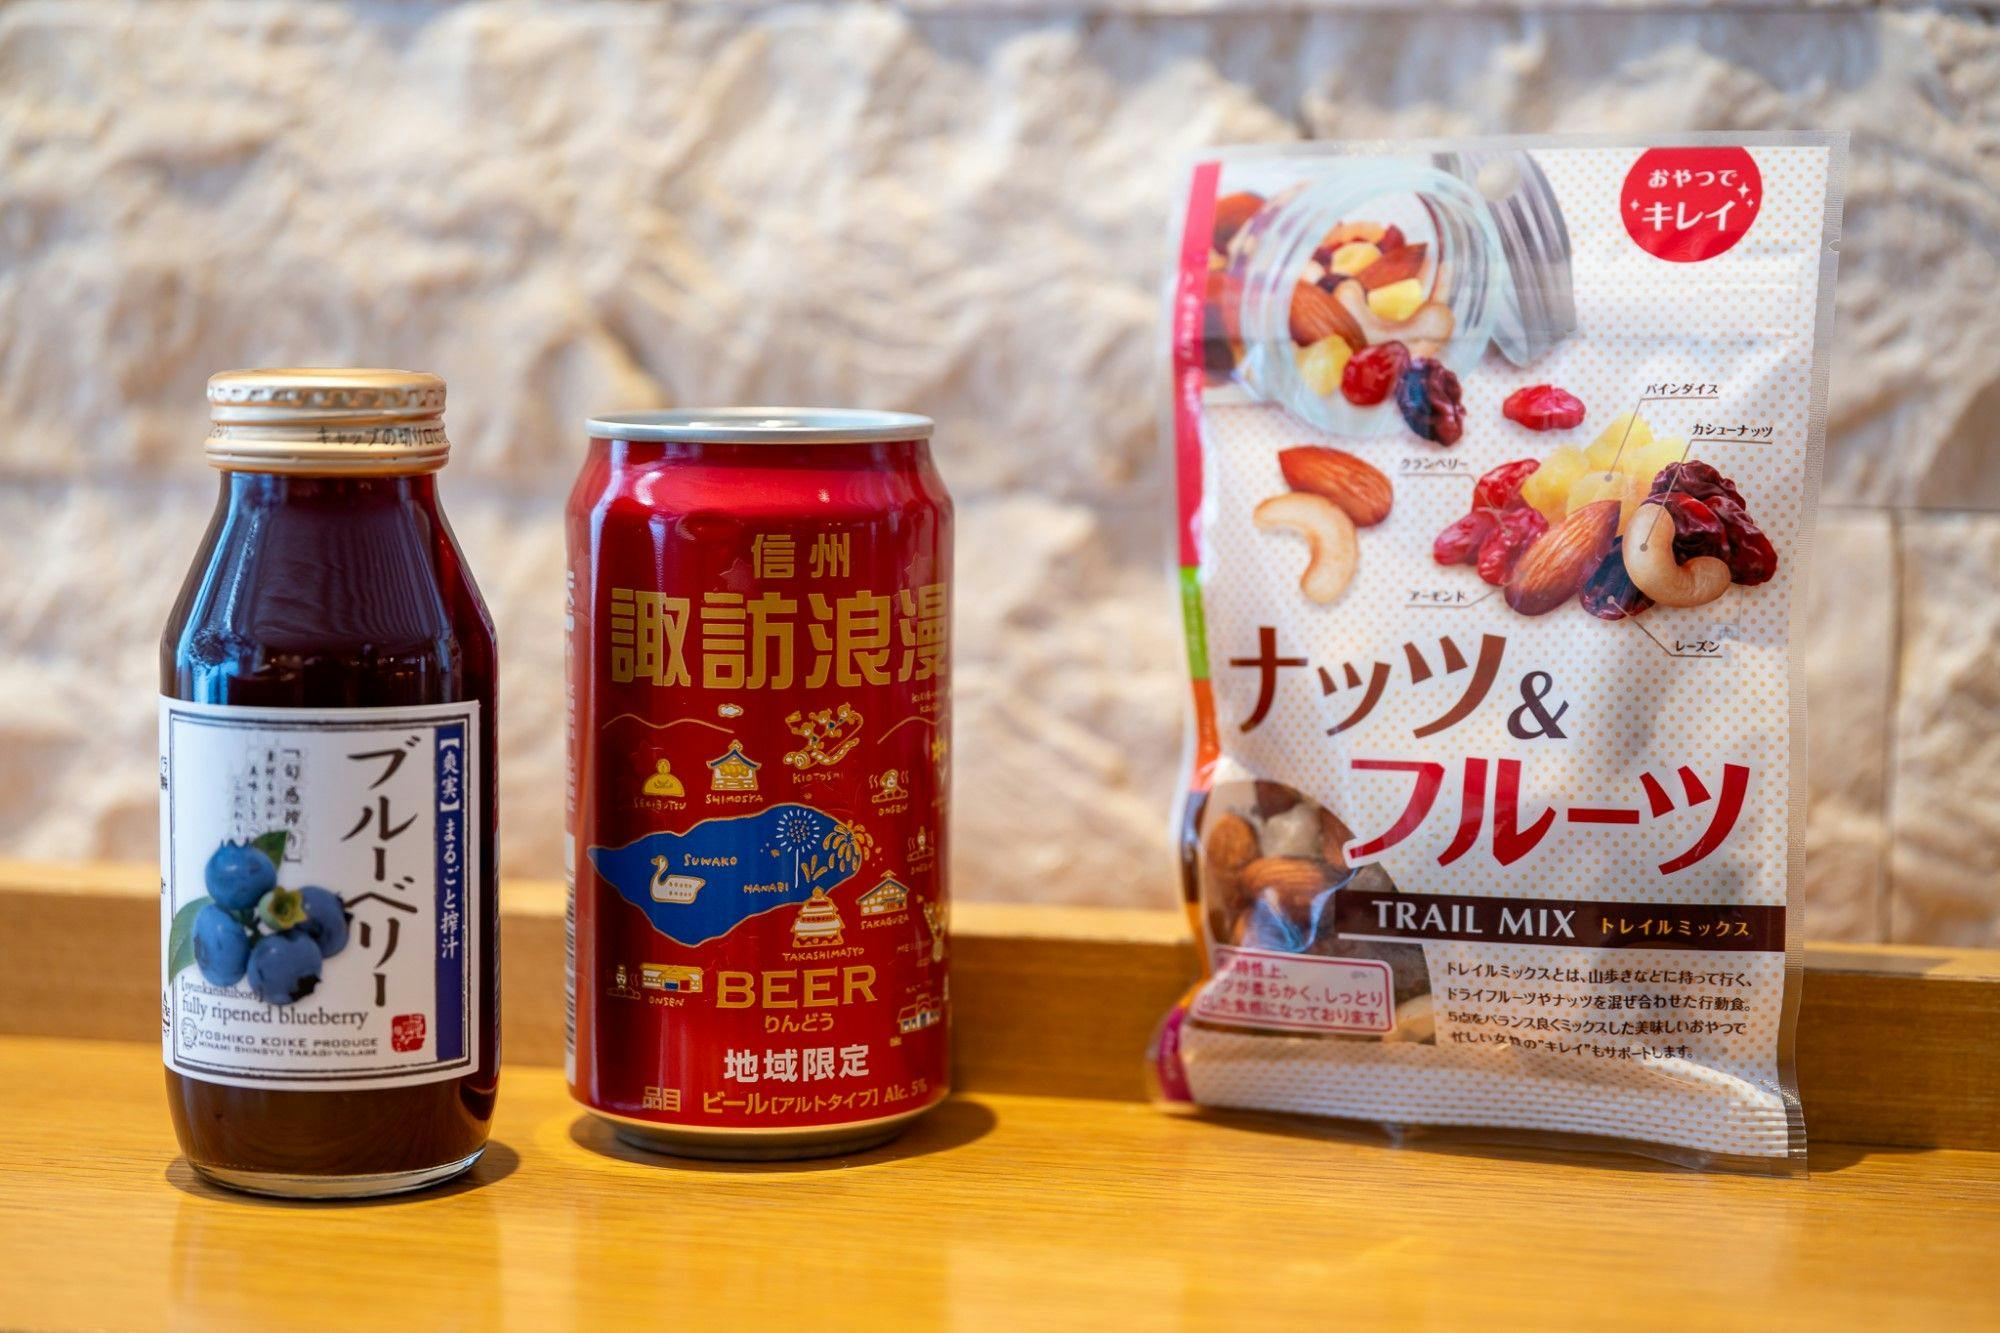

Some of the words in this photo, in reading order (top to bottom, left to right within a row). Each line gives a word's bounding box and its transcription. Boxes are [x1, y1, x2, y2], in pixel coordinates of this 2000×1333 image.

[1648, 169, 1738, 188] おやつで
[1641, 200, 1736, 231] キレイ
[1692, 423, 1774, 438] カシューナッツ
[1400, 457, 1469, 470] クランベリー
[751, 532, 851, 579] 信州
[611, 582, 947, 690] 諏訪浪漫
[1675, 639, 1721, 653] レーズン
[1229, 626, 1507, 740] ナッツ
[1507, 670, 1569, 740] &
[1348, 756, 1750, 875] フルーツ
[341, 735, 420, 1007] ブルーベリー
[684, 853, 738, 867] SUWAKO
[743, 882, 789, 894] HANABI
[1372, 900, 1483, 935] TRAIL
[1498, 905, 1577, 938] MIX
[1601, 916, 1750, 938] トレイルミックス
[649, 997, 685, 1006] ONSEN
[716, 964, 878, 1009] BEER
[182, 995, 208, 1018] fully
[211, 1001, 273, 1025] ripened
[278, 1003, 368, 1029] blueberry
[764, 1012, 835, 1033] りんどう
[198, 1029, 254, 1046] YOSHIKO
[261, 1037, 307, 1048] KOIKE
[313, 1038, 378, 1048] PRODUCE
[724, 1045, 870, 1083] 地域限定
[642, 1086, 681, 1113] 品目
[884, 1089, 908, 1105] Alc.
[910, 1079, 928, 1099] 5%
